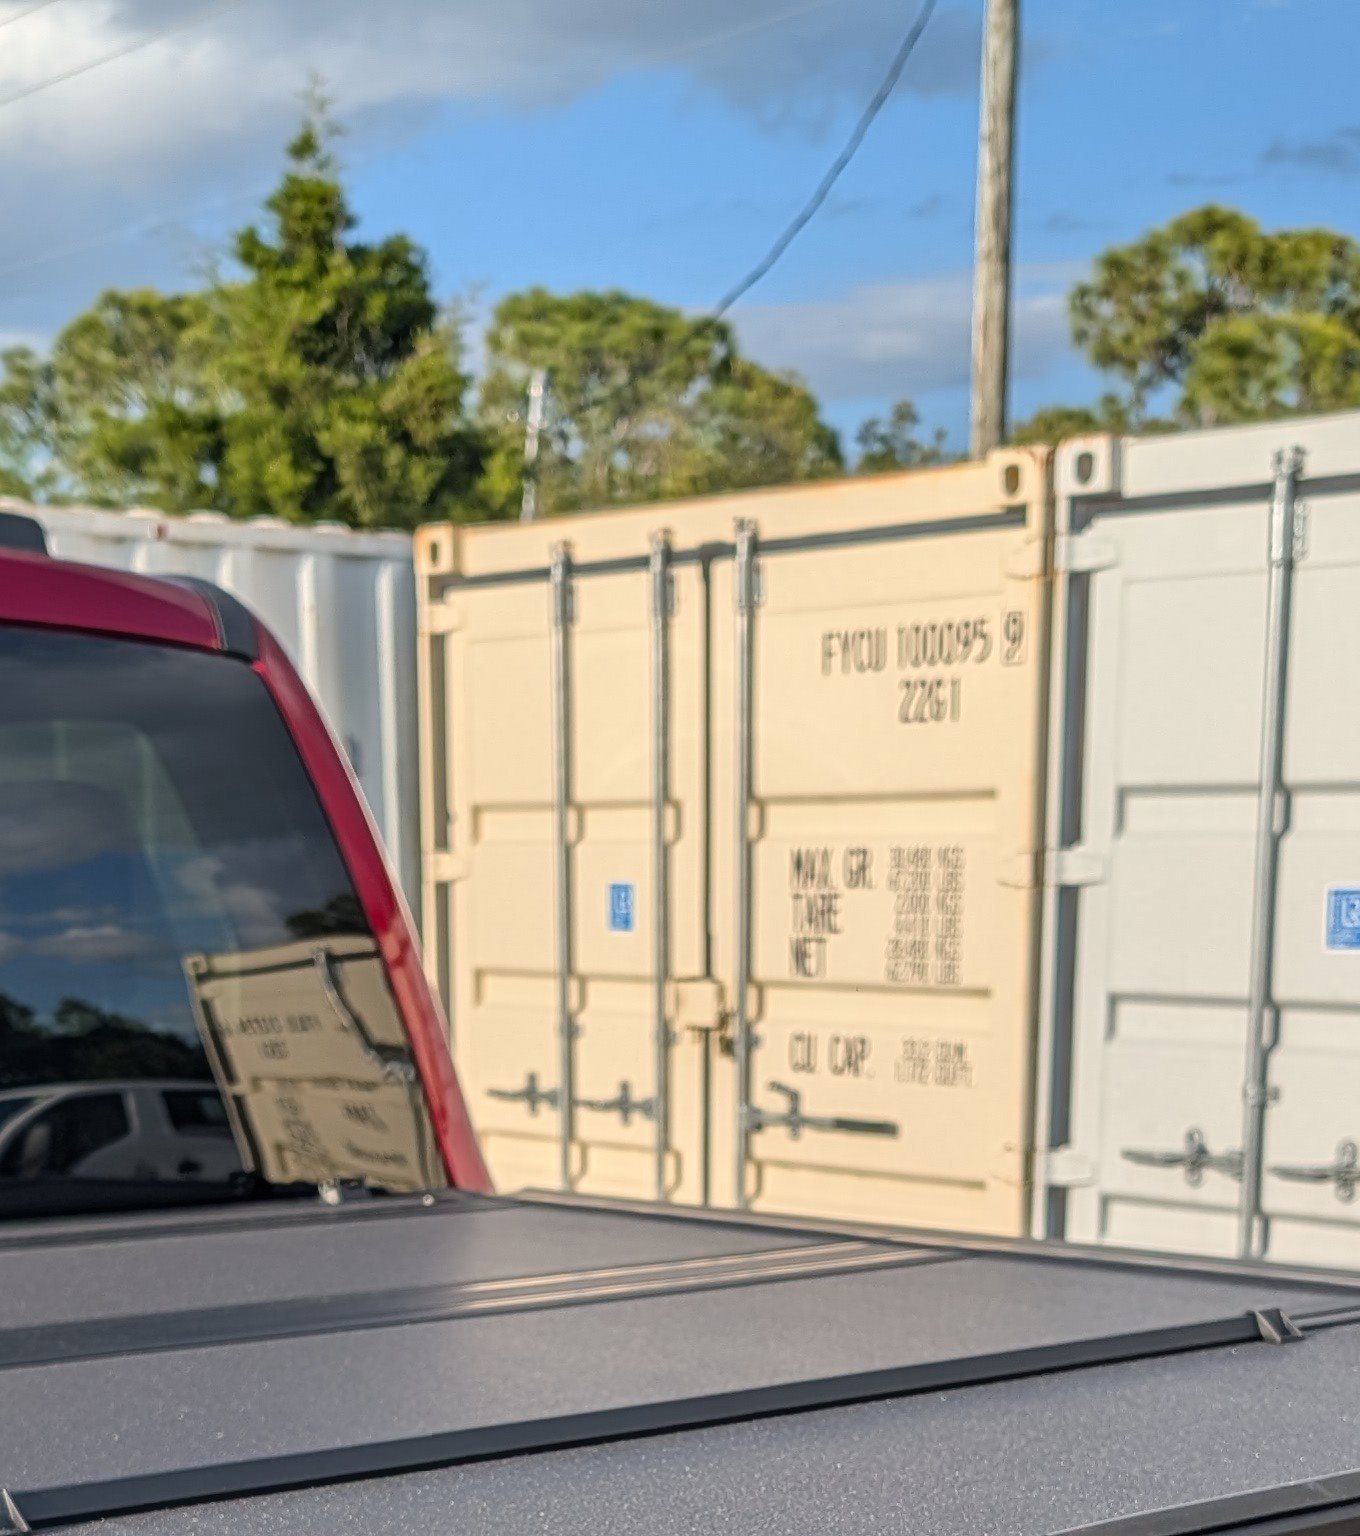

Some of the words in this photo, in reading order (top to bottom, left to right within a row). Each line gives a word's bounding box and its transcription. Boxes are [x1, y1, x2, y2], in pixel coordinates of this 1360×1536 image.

[821, 628, 887, 676] FYCU
[898, 676, 962, 723] 22G1
[792, 892, 843, 935] TARE
[790, 936, 827, 977] NET
